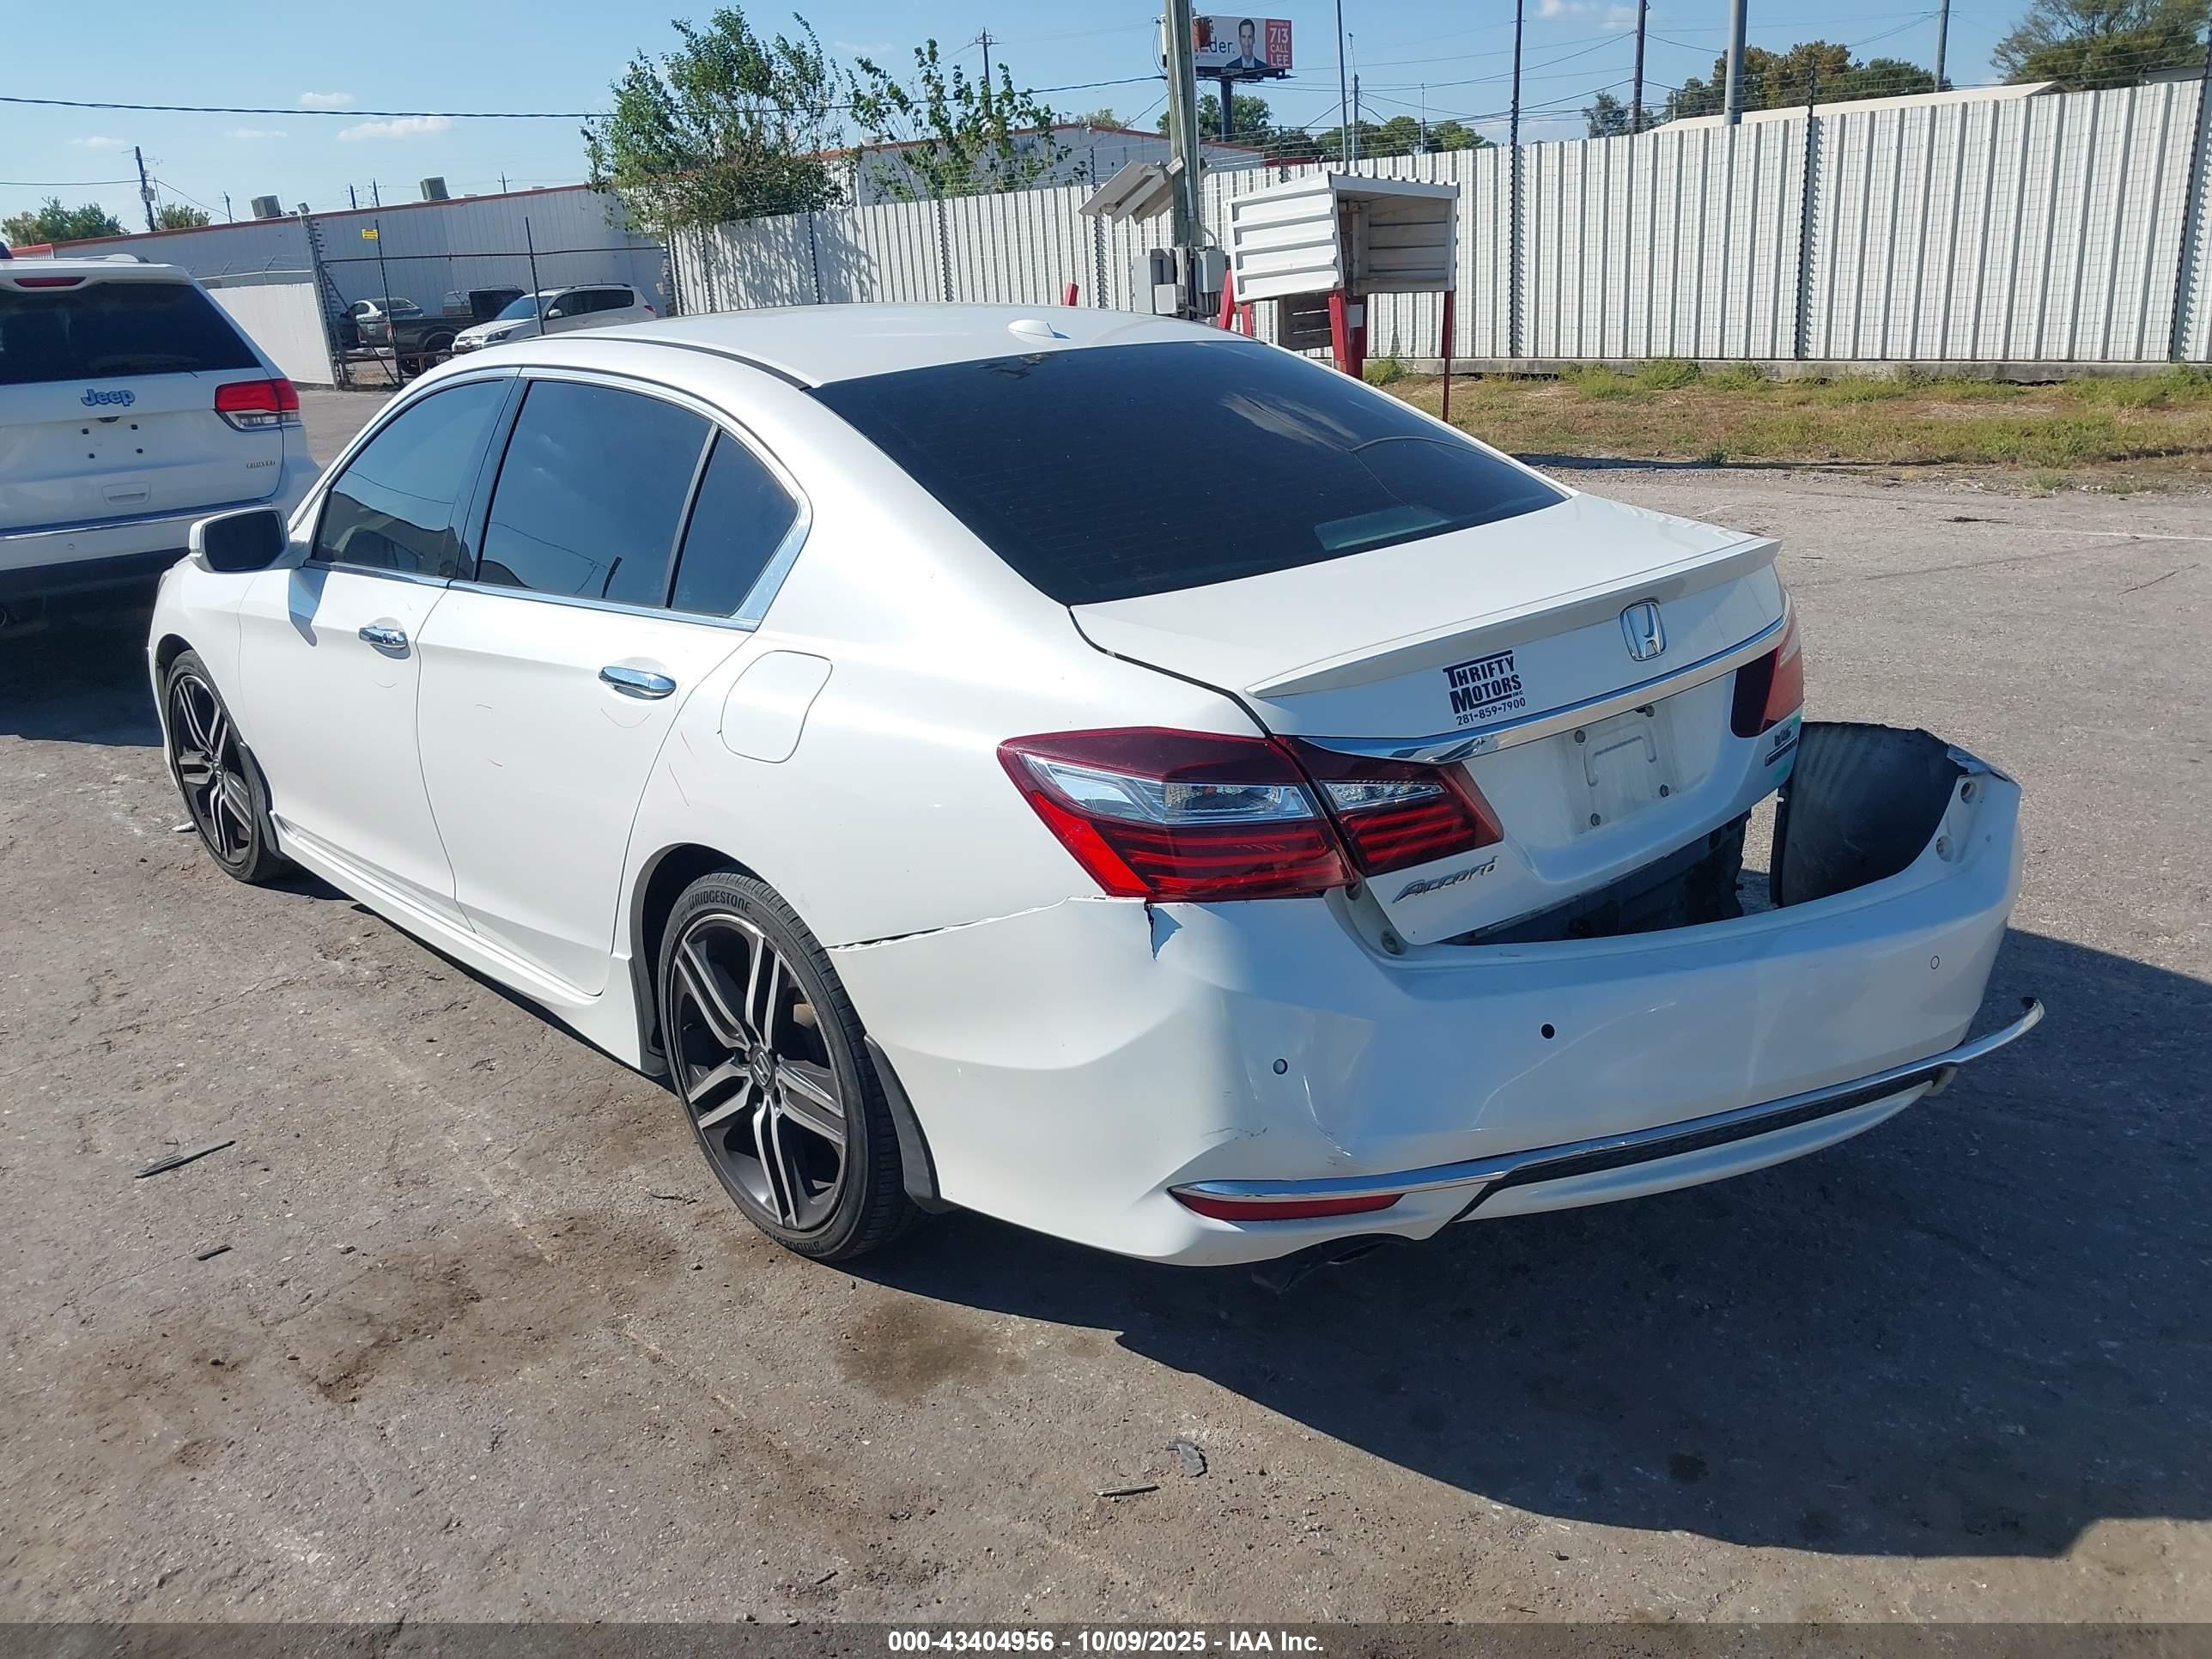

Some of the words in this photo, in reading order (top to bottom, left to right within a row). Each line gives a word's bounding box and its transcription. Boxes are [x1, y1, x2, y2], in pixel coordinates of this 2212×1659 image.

[1270, 27, 1289, 44] 713
[1271, 44, 1289, 53] CALL
[1271, 54, 1290, 67] LEE
[81, 388, 136, 407] Jeep
[1449, 674, 1522, 714] MOTORS
[1456, 697, 1526, 726] 281-859-7900
[688, 890, 751, 914] BRIDGESTONE
